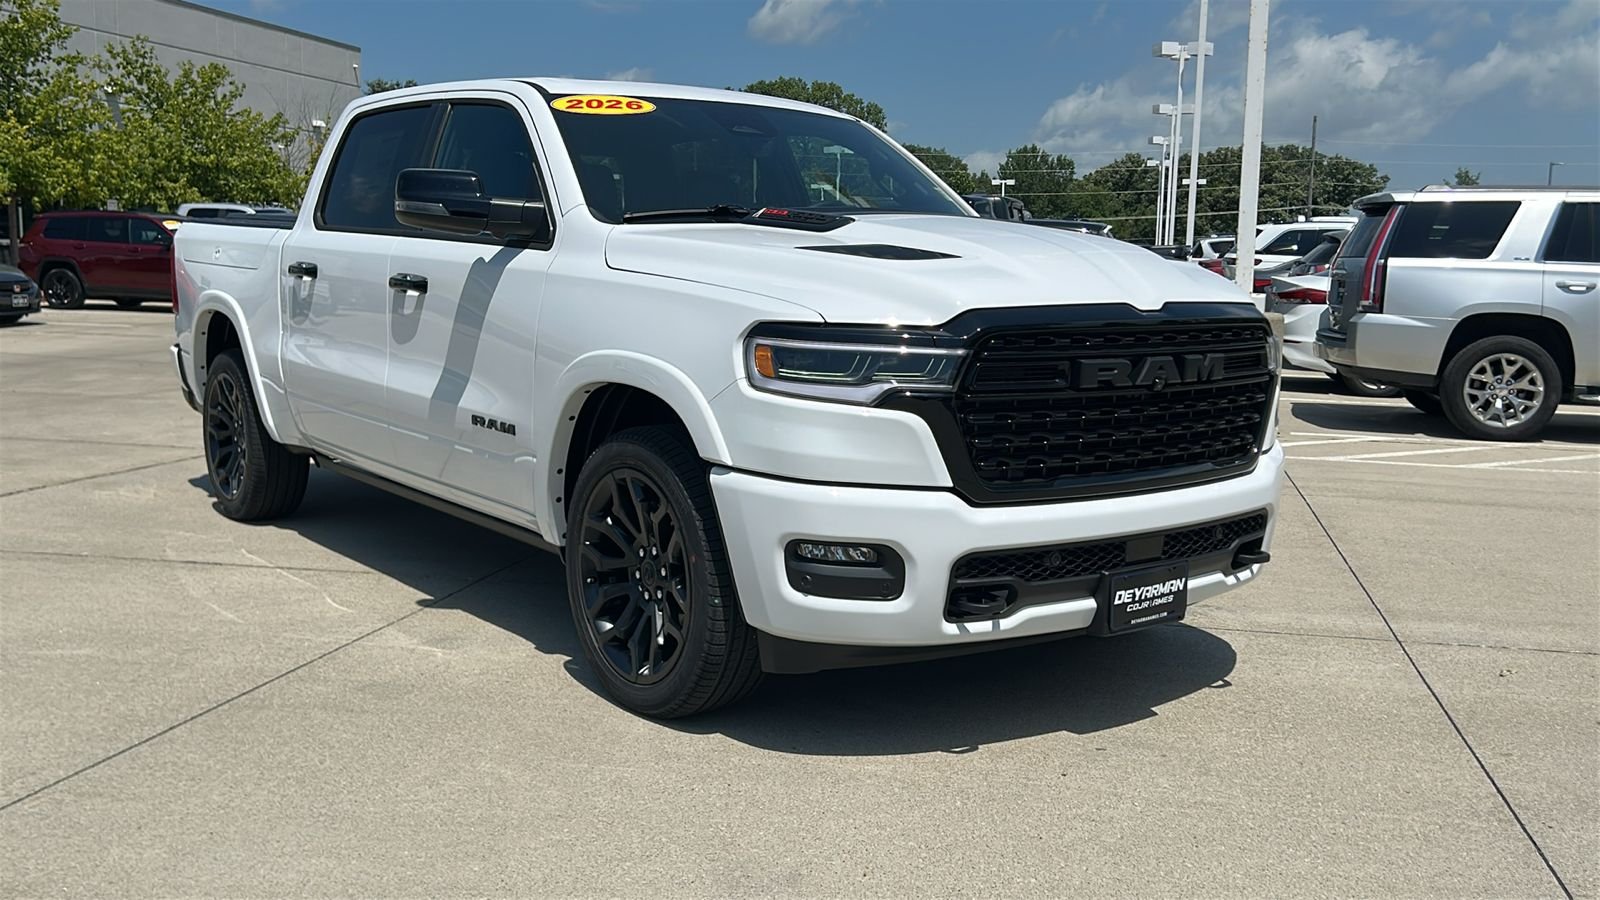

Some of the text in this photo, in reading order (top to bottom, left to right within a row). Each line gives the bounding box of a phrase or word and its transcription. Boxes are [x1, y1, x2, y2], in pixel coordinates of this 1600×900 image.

[565, 99, 643, 110] 2026
[1076, 353, 1225, 388] RAM
[471, 414, 516, 436] RAM
[1113, 577, 1186, 605] DEYARMAN
[1152, 594, 1174, 606] AMES
